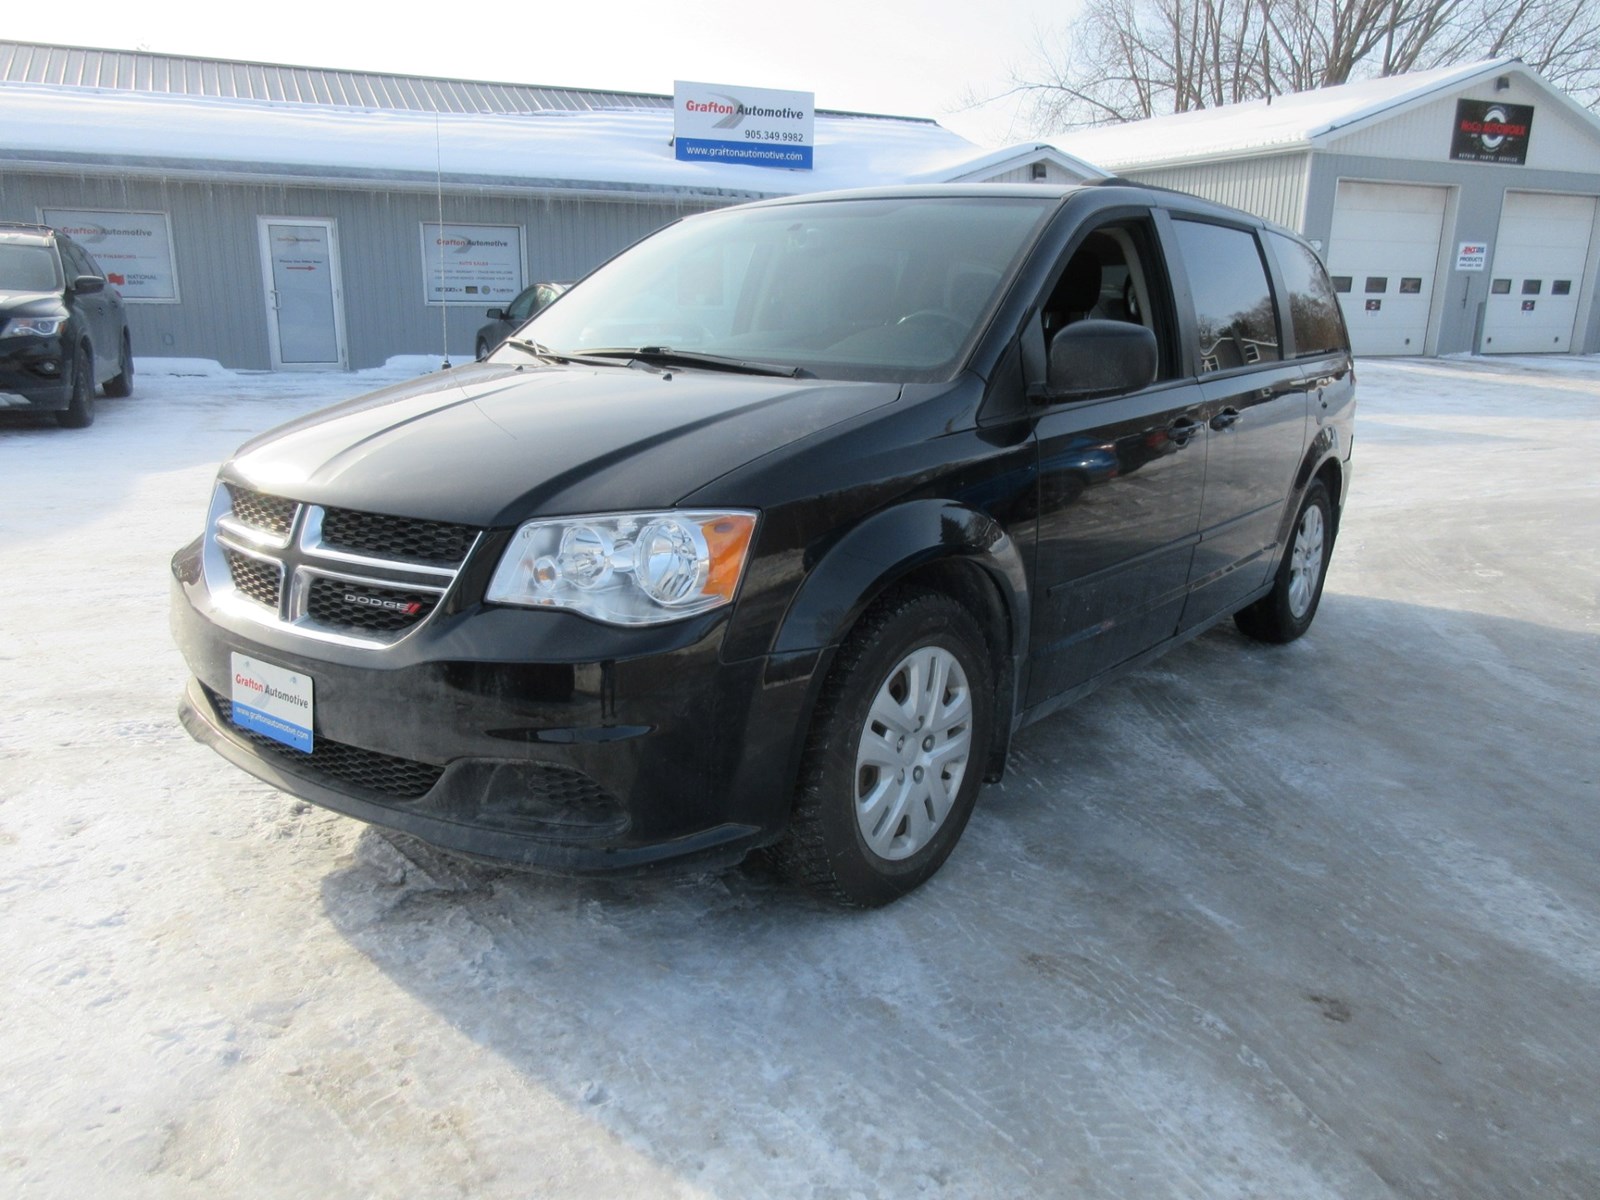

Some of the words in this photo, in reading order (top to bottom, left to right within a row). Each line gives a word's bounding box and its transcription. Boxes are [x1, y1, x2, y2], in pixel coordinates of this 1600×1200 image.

[686, 100, 733, 115] Grafton
[736, 104, 804, 119] Automotive
[745, 129, 804, 142] 905.349.9982
[687, 146, 803, 161] www.graftonautomotive.com
[62, 226, 98, 235] Grafton
[101, 227, 153, 237] Automotive
[344, 594, 409, 611] DODGE
[235, 674, 263, 692] Grafton
[264, 684, 309, 709] Automotive
